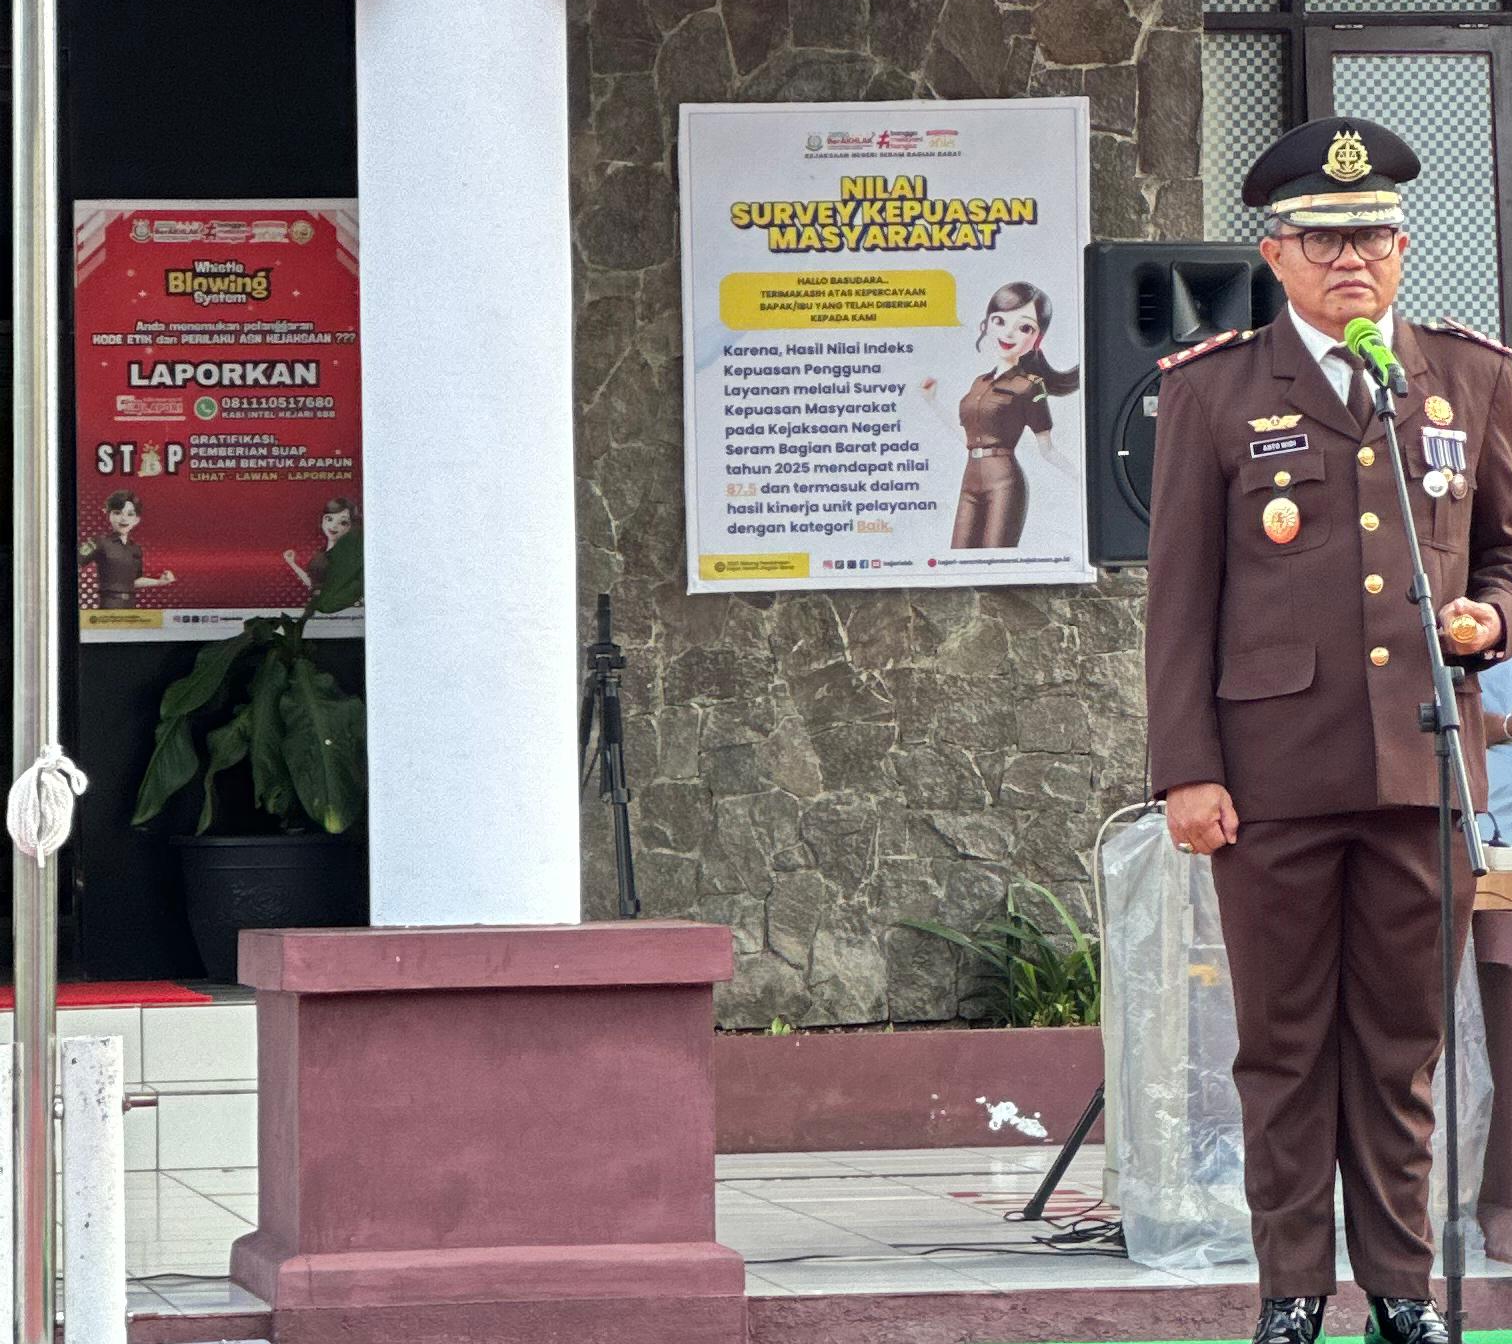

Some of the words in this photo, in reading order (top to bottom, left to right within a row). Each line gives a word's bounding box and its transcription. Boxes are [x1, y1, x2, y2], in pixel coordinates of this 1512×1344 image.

[840, 175, 927, 201] NILAI
[730, 200, 861, 229] SURVEY
[860, 197, 1038, 226] KEPUASAN
[768, 222, 1001, 253] MASYARAKAT
[193, 260, 244, 274] Whistle
[167, 269, 270, 299] Blowing
[797, 277, 828, 285] HALLO
[193, 291, 247, 307] System
[760, 289, 826, 298] TERIMAKASIH
[827, 289, 853, 297] ATAS
[854, 288, 926, 297] KEPERCAYAAN
[815, 301, 843, 310] YANG
[844, 300, 875, 309] TELAH
[876, 300, 928, 309] DIBERIKAN
[810, 313, 849, 322] KEPADA
[851, 313, 877, 322] KAMI
[156, 335, 178, 345] dan
[723, 344, 783, 357] Karena,
[786, 342, 824, 356] Hasil
[826, 342, 861, 355] Nilai
[863, 341, 914, 354] Indeks
[129, 361, 317, 387] LAPORKAN
[723, 364, 801, 380] Kepuasan
[804, 362, 882, 378] Pengguna
[724, 384, 790, 399] Layanan
[793, 381, 851, 395] melalui
[853, 382, 907, 397] Survey
[724, 403, 801, 419] Kepuasan
[805, 401, 897, 417] Masyarakat
[725, 424, 765, 439] pada
[768, 422, 849, 438] Kejaksaan
[851, 420, 902, 436] Negeri
[271, 446, 307, 456] SUAP
[725, 443, 775, 455] Seram
[778, 441, 832, 457] Bagian
[835, 441, 877, 453] Barat
[879, 440, 920, 455] pada
[190, 459, 236, 469] DALAM
[239, 458, 294, 469] BENTUK
[298, 457, 353, 468] APAPUN
[725, 463, 772, 475] tahun
[774, 462, 810, 474] 2025
[813, 460, 894, 475] mendapat
[896, 459, 929, 472] nilai
[760, 481, 790, 494] dan
[793, 480, 867, 493] termasuk
[869, 479, 920, 492] dalam
[727, 502, 763, 514] hasil
[766, 500, 820, 516] kinerja
[822, 500, 853, 512] unit
[855, 499, 937, 515] pelayanan
[727, 521, 786, 537] dengan
[789, 519, 854, 535] kategori
